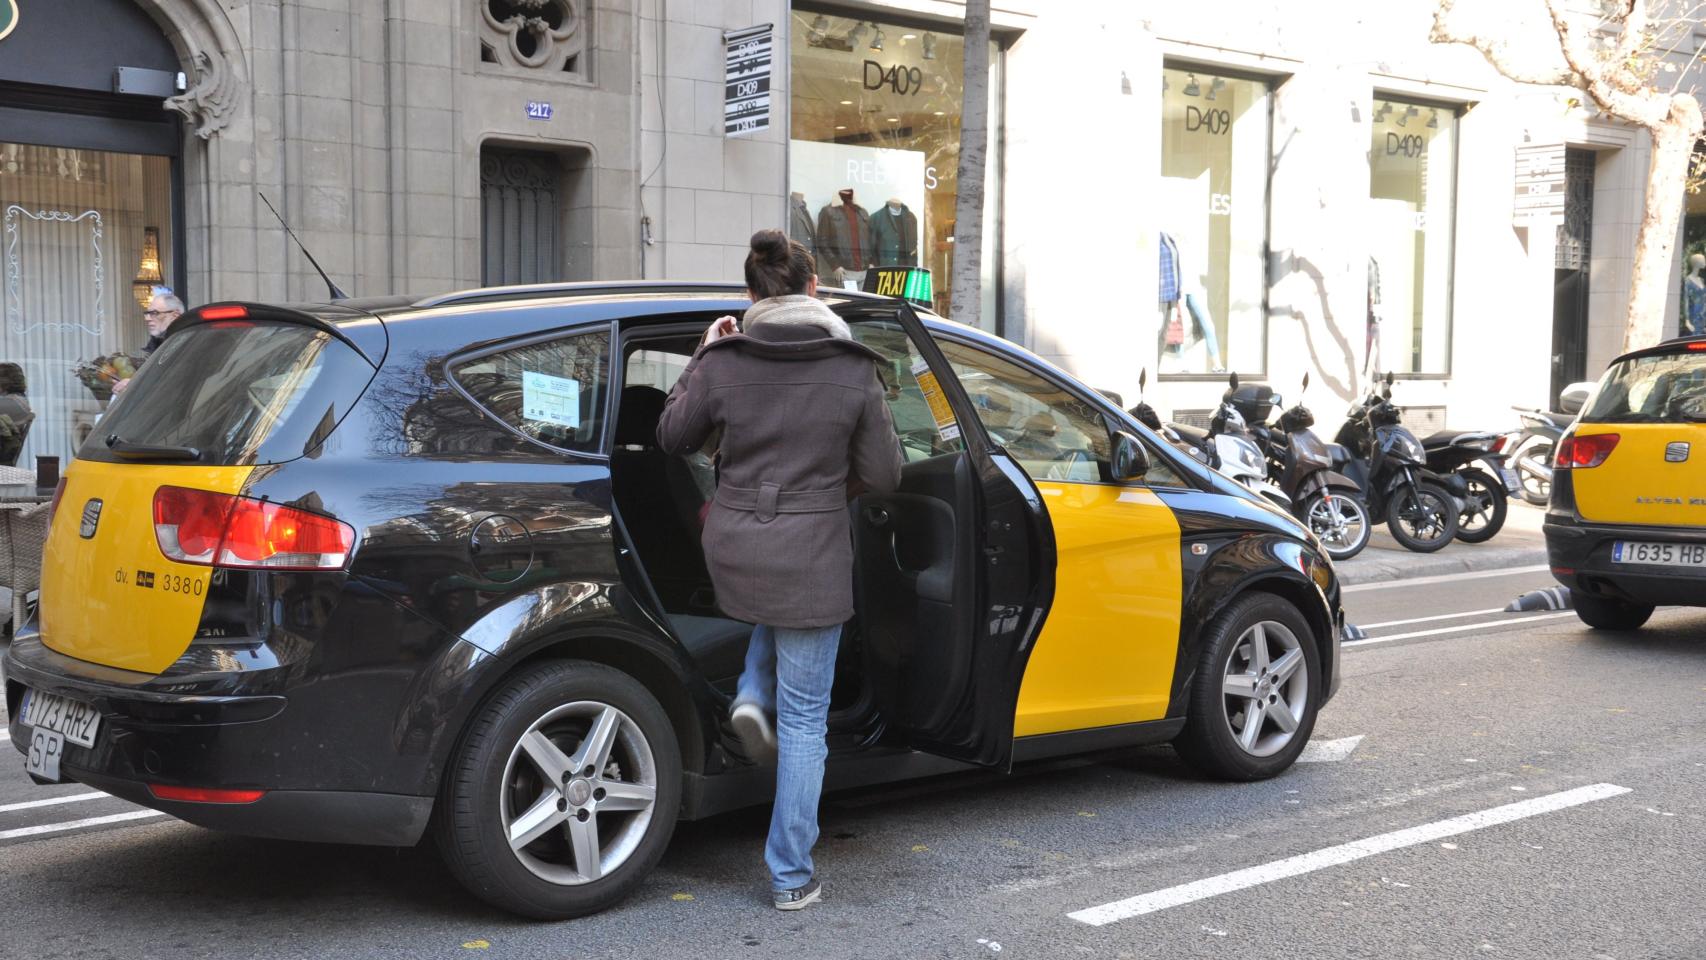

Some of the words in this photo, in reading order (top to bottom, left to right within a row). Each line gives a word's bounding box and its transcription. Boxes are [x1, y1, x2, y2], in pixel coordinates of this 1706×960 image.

[737, 81, 758, 97] D409
[864, 60, 922, 96] D409
[529, 102, 549, 117] 217
[1186, 105, 1230, 135] D409
[1386, 132, 1423, 158] D409
[877, 271, 907, 295] TAXI
[1628, 543, 1673, 562] 1635
[163, 574, 203, 596] 3380
[29, 690, 64, 729] 1173
[32, 733, 58, 771] SP
